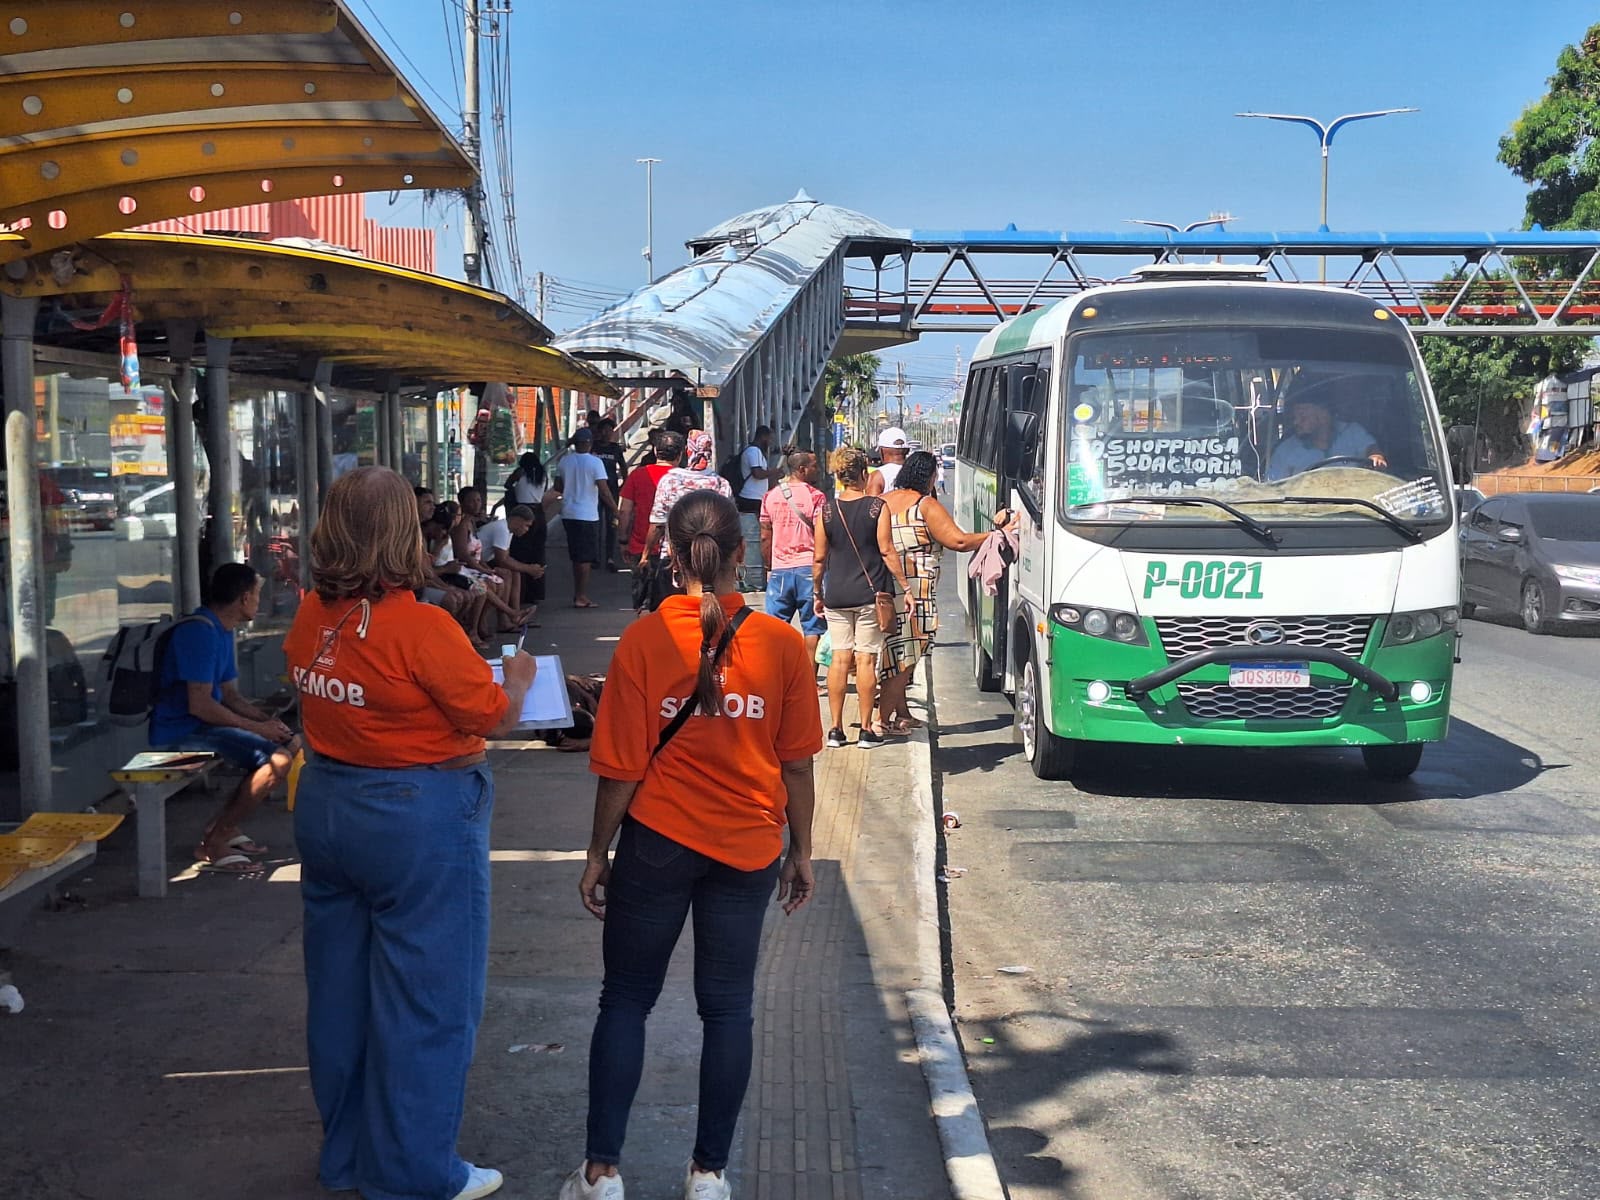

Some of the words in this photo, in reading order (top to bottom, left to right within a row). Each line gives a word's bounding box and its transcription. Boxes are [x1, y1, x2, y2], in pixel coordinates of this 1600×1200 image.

[1107, 438, 1224, 454] SHOPPING
[1143, 560, 1264, 599] P-0021
[660, 693, 765, 719] SOB
